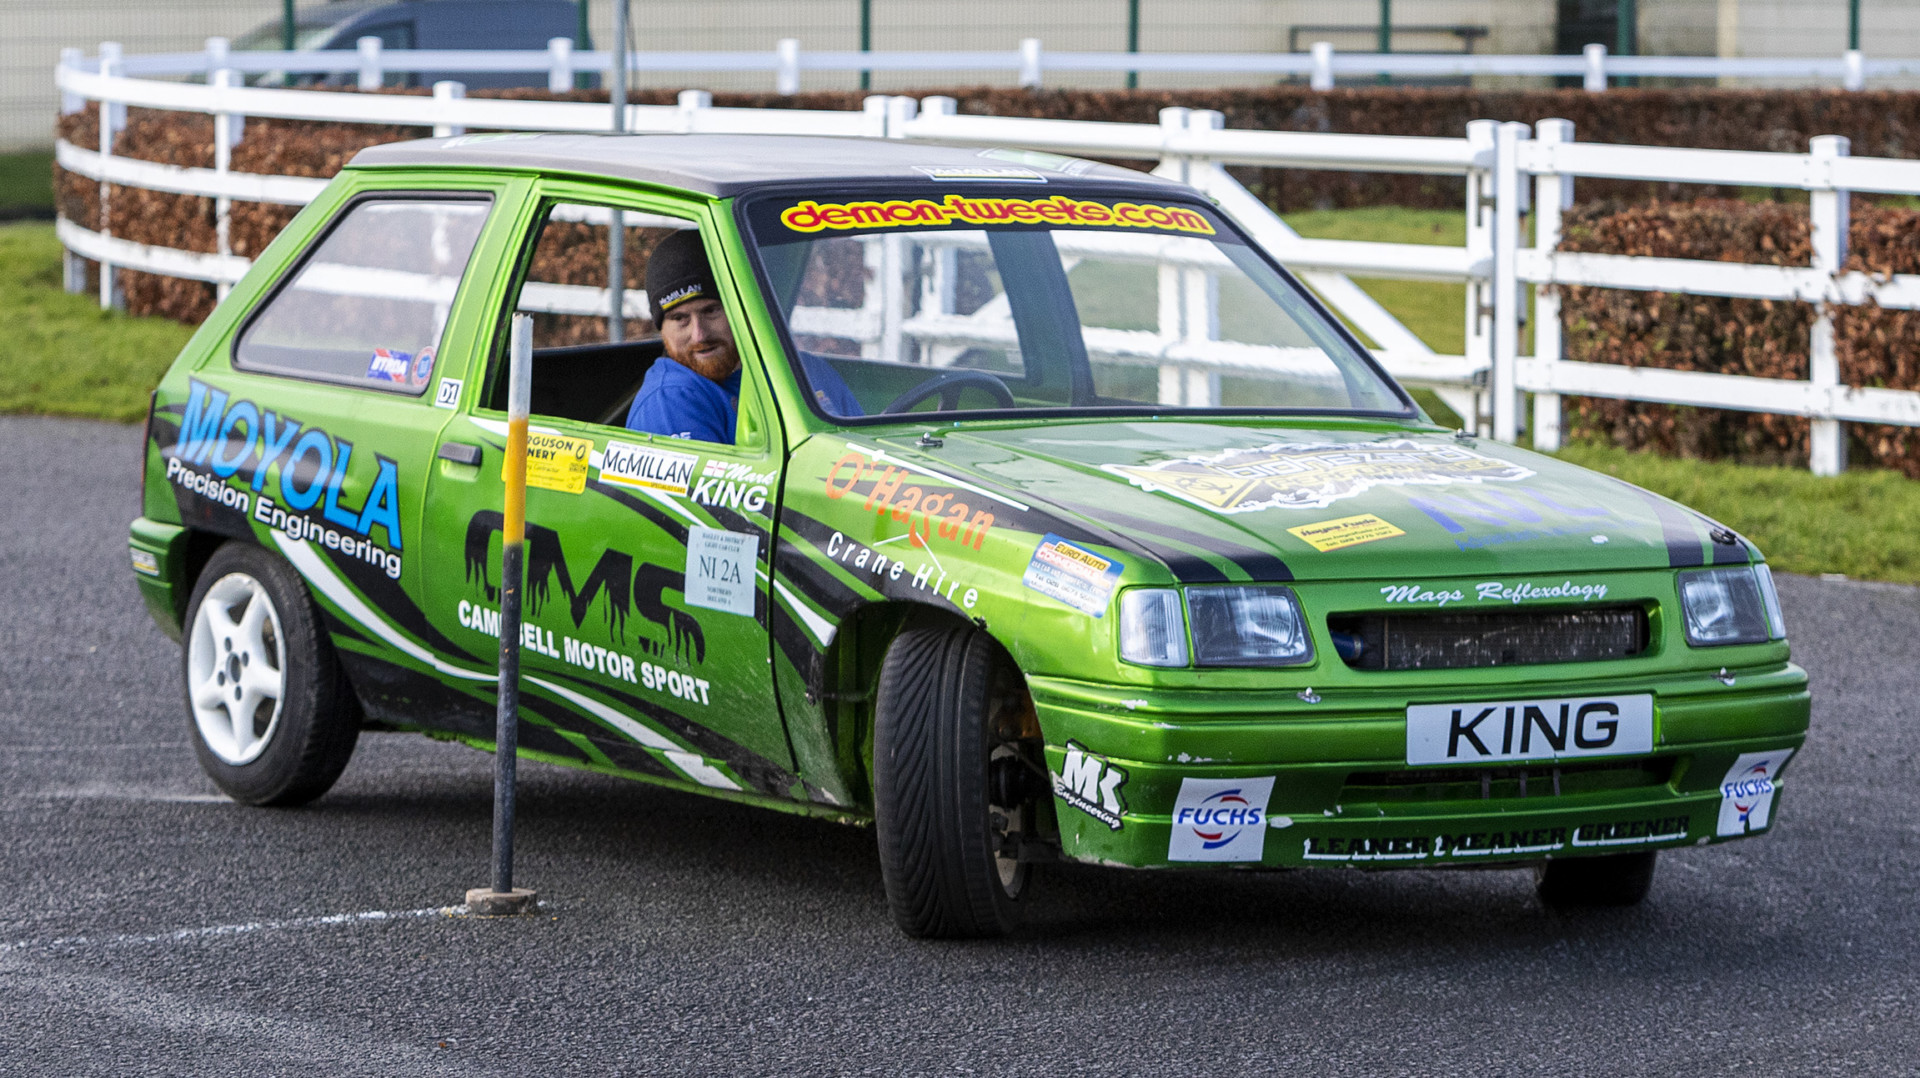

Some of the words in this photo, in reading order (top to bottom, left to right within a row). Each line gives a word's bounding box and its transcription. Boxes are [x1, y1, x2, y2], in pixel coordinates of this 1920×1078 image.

[782, 196, 1216, 235] demon-tweeks.com
[174, 377, 403, 550] MOYOLA
[527, 435, 574, 451] RGUSON
[602, 449, 695, 485] McMILLAN
[725, 462, 777, 485] Mark
[691, 477, 768, 511] KING
[825, 452, 995, 550] O'Hagan
[167, 457, 250, 513] Precision
[254, 497, 402, 579] Engineering
[699, 555, 716, 579] NI
[721, 559, 741, 584] 2A
[826, 531, 905, 581] Crane
[912, 563, 979, 608] Hire
[1055, 543, 1080, 560] EURO
[1079, 555, 1107, 571] AUTO
[464, 509, 705, 667] CMS
[1380, 585, 1465, 607] Mags
[1476, 581, 1608, 603] Reflexology
[458, 599, 561, 659] CAMELL
[564, 636, 637, 685] MOTOR
[641, 661, 710, 705] SPORT
[1447, 702, 1619, 757] KING
[1061, 742, 1125, 815] MK
[1724, 776, 1773, 799] FUCHS
[1054, 783, 1123, 829] Engineering
[1177, 807, 1262, 825] FUCHS
[1304, 837, 1430, 859] LEANER
[1434, 827, 1566, 857] MEANER
[1572, 815, 1690, 847] GREENER
